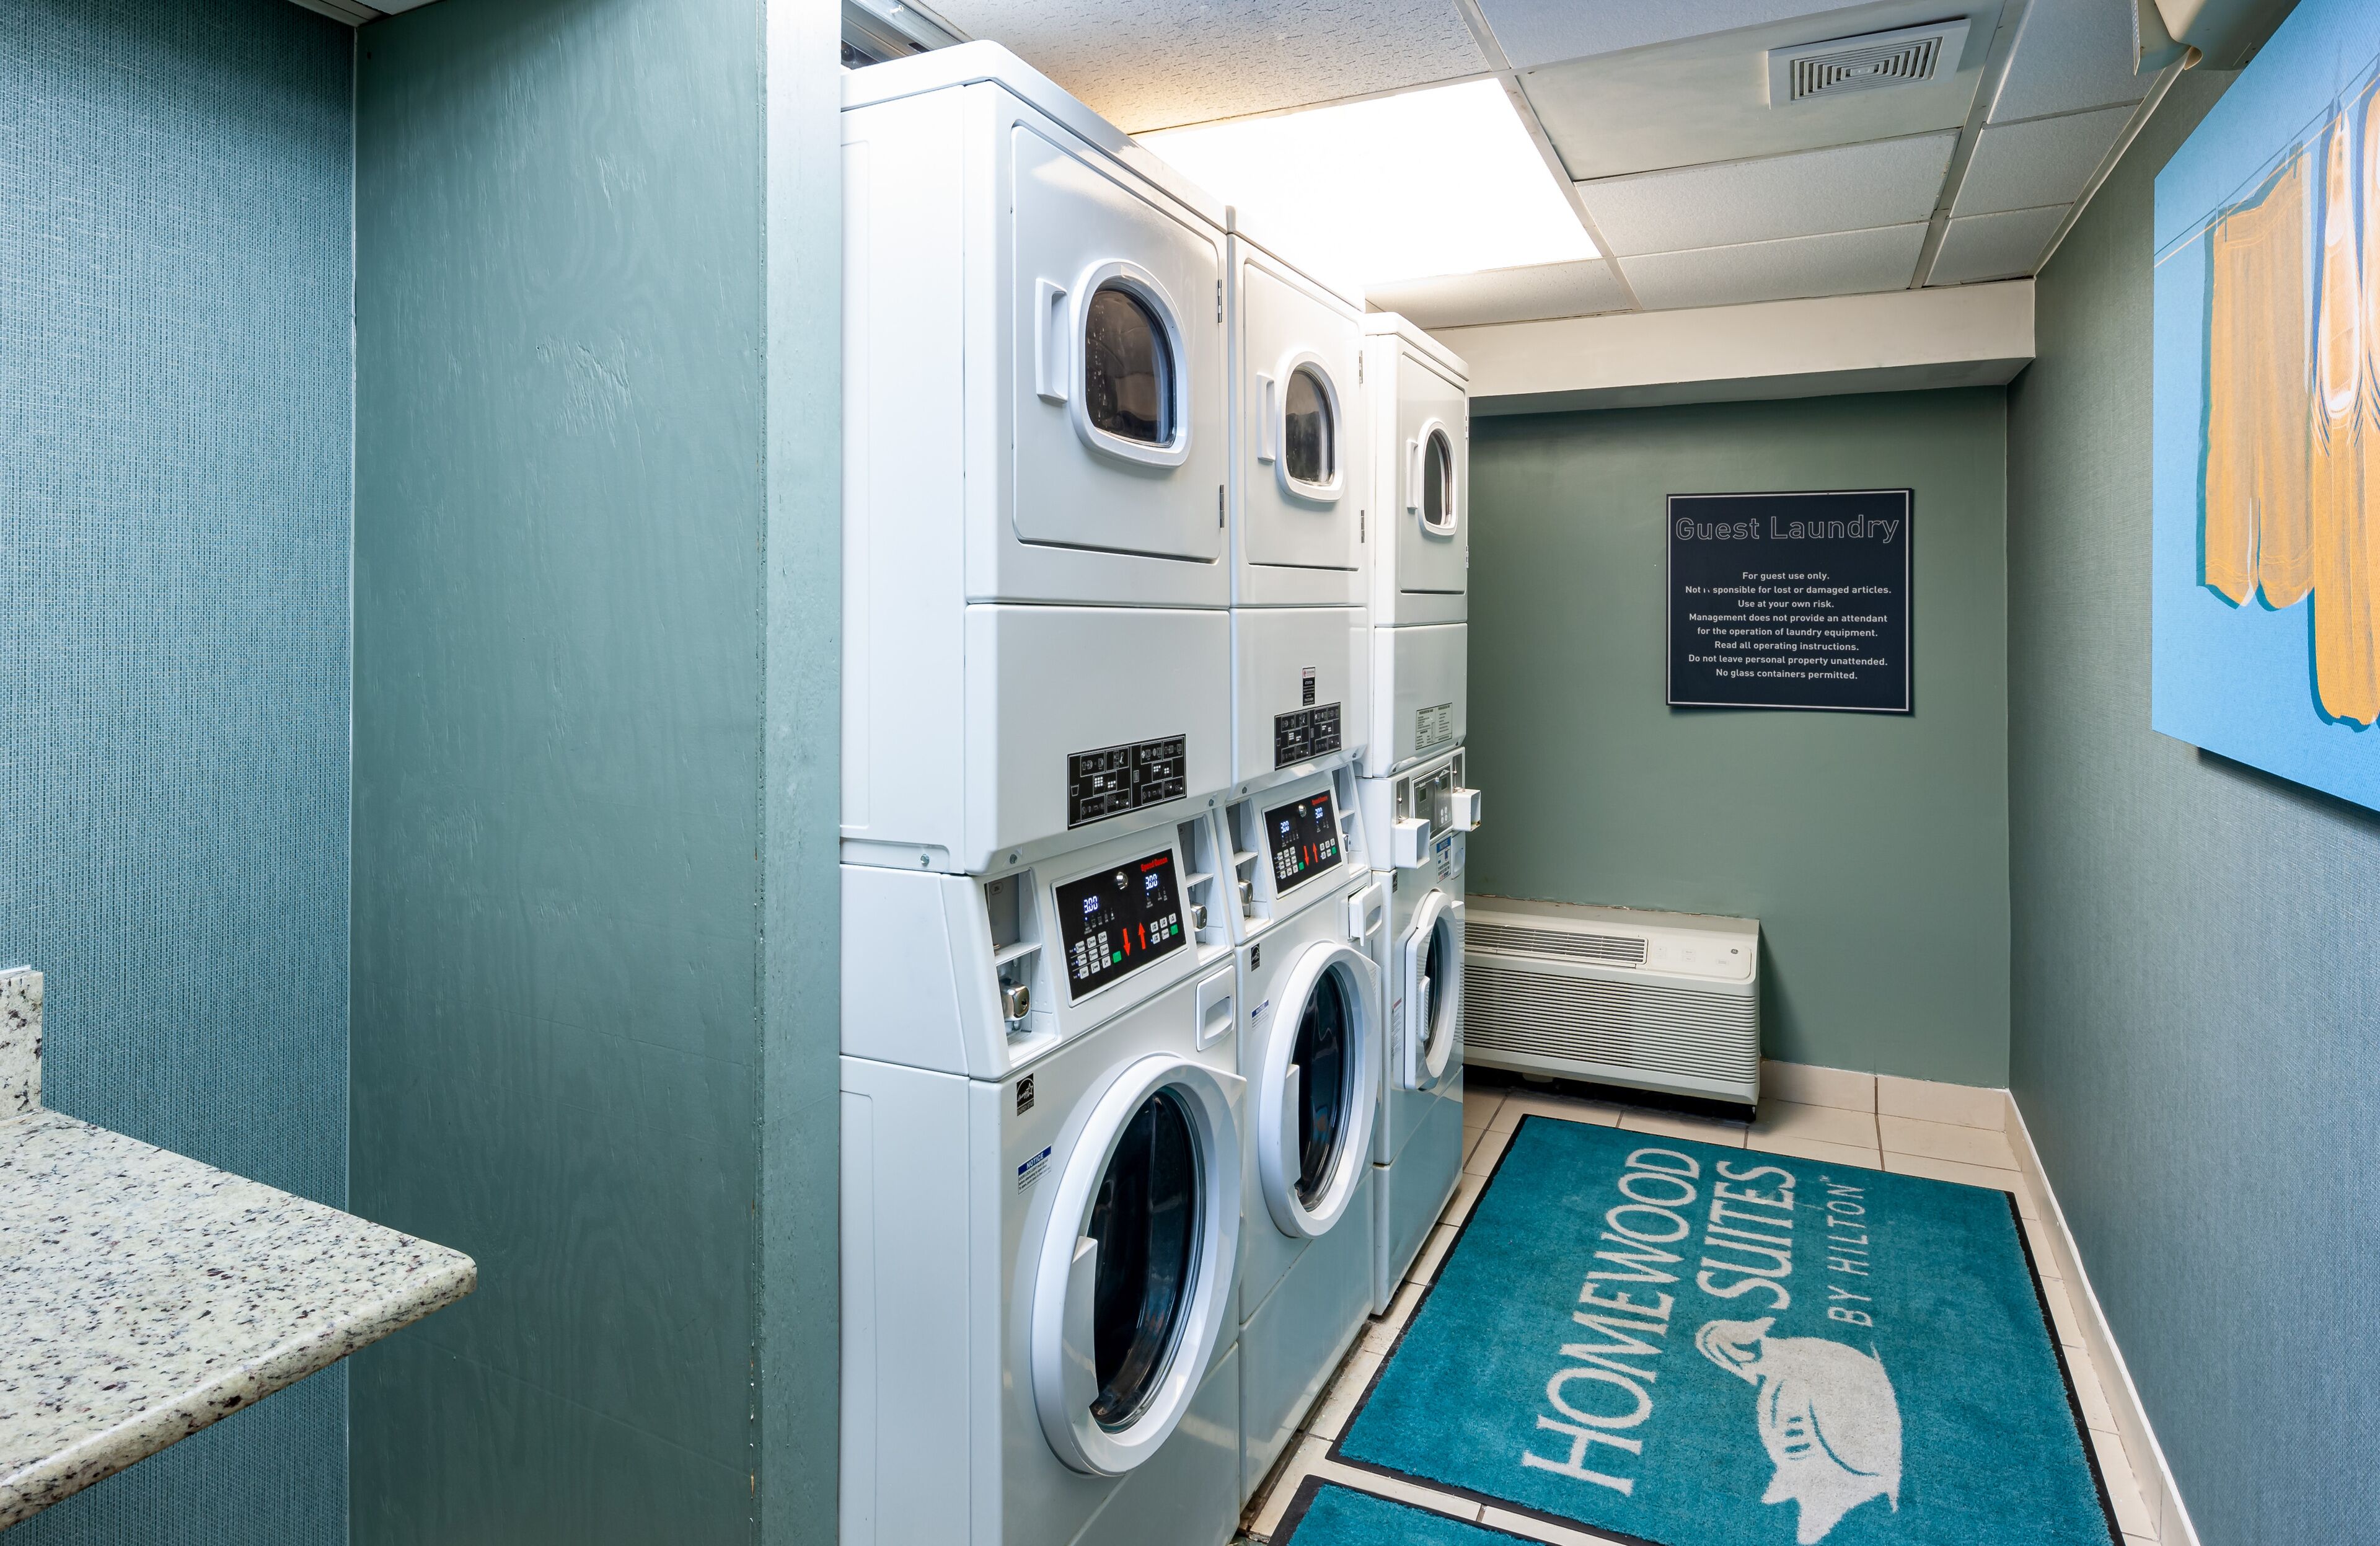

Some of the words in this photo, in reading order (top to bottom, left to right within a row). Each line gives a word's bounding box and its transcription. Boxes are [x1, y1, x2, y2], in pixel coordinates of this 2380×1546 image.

[1676, 517, 1760, 541] Guest
[1771, 514, 1900, 544] Laundry
[1742, 572, 1758, 580] For
[1760, 572, 1786, 581] guest
[1807, 572, 1830, 581] only.
[1685, 585, 1701, 594] Not
[1758, 585, 1773, 594] for
[1774, 585, 1791, 594] lost
[1806, 585, 1849, 596] damaged
[1851, 585, 1892, 594] articles.
[1738, 599, 1755, 607] Use
[1768, 601, 1790, 609] your
[1813, 599, 1835, 608] risk.
[1689, 612, 1747, 623] Management
[1748, 613, 1771, 622] does
[1790, 614, 1825, 624] provide
[1841, 614, 1888, 622] attendant
[1697, 627, 1711, 635] for
[1712, 627, 1727, 635] the
[1729, 627, 1773, 637] operation
[1774, 627, 1784, 635] of
[1786, 627, 1822, 638] laundry
[1824, 628, 1878, 638] equipment.
[1714, 640, 1737, 649] Read
[1739, 641, 1752, 649] all
[1753, 642, 1797, 652] operating
[1800, 642, 1859, 651] instructions.
[1688, 654, 1701, 662] Do
[1703, 655, 1717, 663] not
[1719, 655, 1743, 663] leave
[1745, 656, 1786, 665] personal
[1787, 656, 1828, 666] property
[1830, 657, 1888, 666] unattended.
[1716, 668, 1729, 676] No
[1730, 669, 1755, 679] glass
[1756, 669, 1806, 678] containers
[1808, 671, 1858, 680] permitted.
[1026, 1152, 1044, 1170] NOTICE
[1696, 1160, 1796, 1310] SUITES
[1826, 1183, 1869, 1276] HILTON
[1827, 1284, 1873, 1327] BY
[1522, 1147, 1700, 1496] HOMEWOOD
